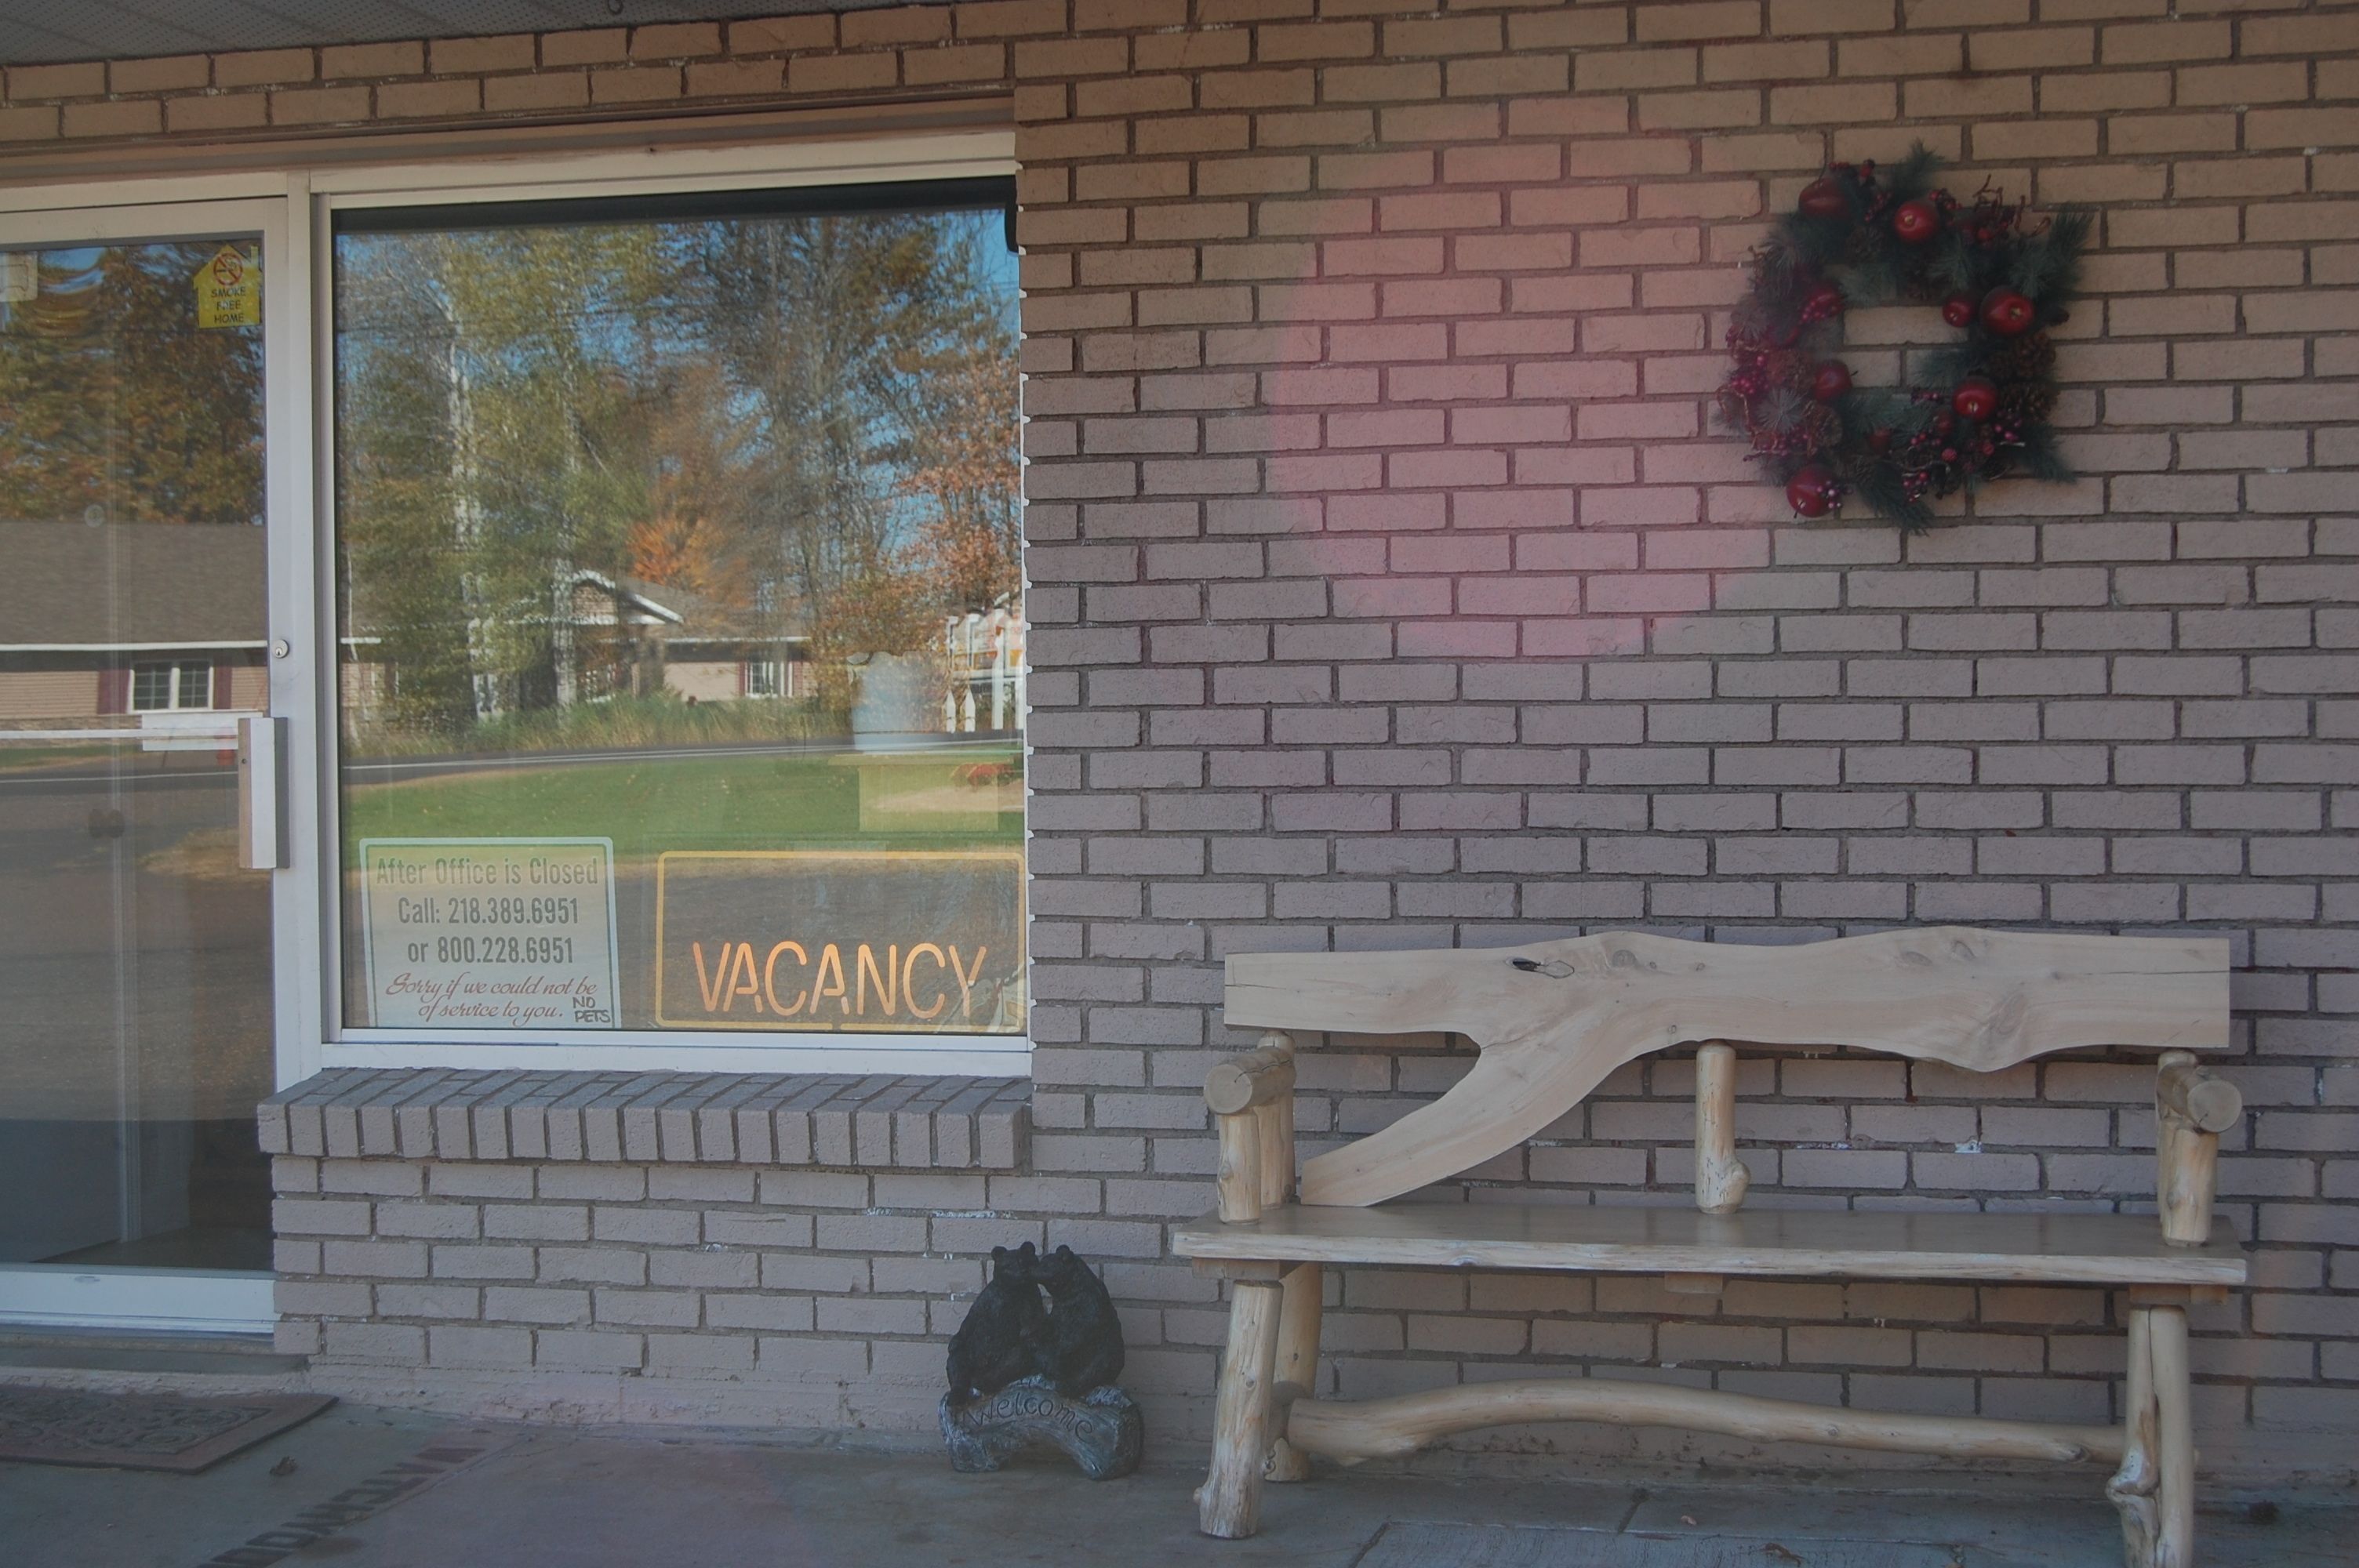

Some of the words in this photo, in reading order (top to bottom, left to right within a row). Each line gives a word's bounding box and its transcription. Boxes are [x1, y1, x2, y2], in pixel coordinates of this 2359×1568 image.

[211, 286, 246, 298] SMOKE
[216, 299, 242, 311] FREE
[214, 313, 245, 324] HOME
[376, 858, 426, 885] After
[434, 858, 497, 885] Office
[504, 858, 522, 885] is
[529, 858, 598, 885] Closed
[398, 897, 440, 924] Call:
[448, 897, 579, 924] 218.389.6951
[408, 942, 429, 963] or
[438, 936, 573, 964] 800.228.6951
[385, 972, 442, 1004] Sorry
[445, 971, 471, 1000] if
[463, 982, 488, 994] we
[490, 975, 544, 995] could
[543, 978, 574, 995] not
[576, 975, 597, 995] be
[693, 940, 987, 1019] VACANCY
[418, 994, 449, 1022] of
[438, 1003, 499, 1017] service
[503, 1000, 520, 1017] to
[512, 1006, 563, 1027] you.
[572, 996, 596, 1009] NO
[575, 1009, 611, 1023] PETS
